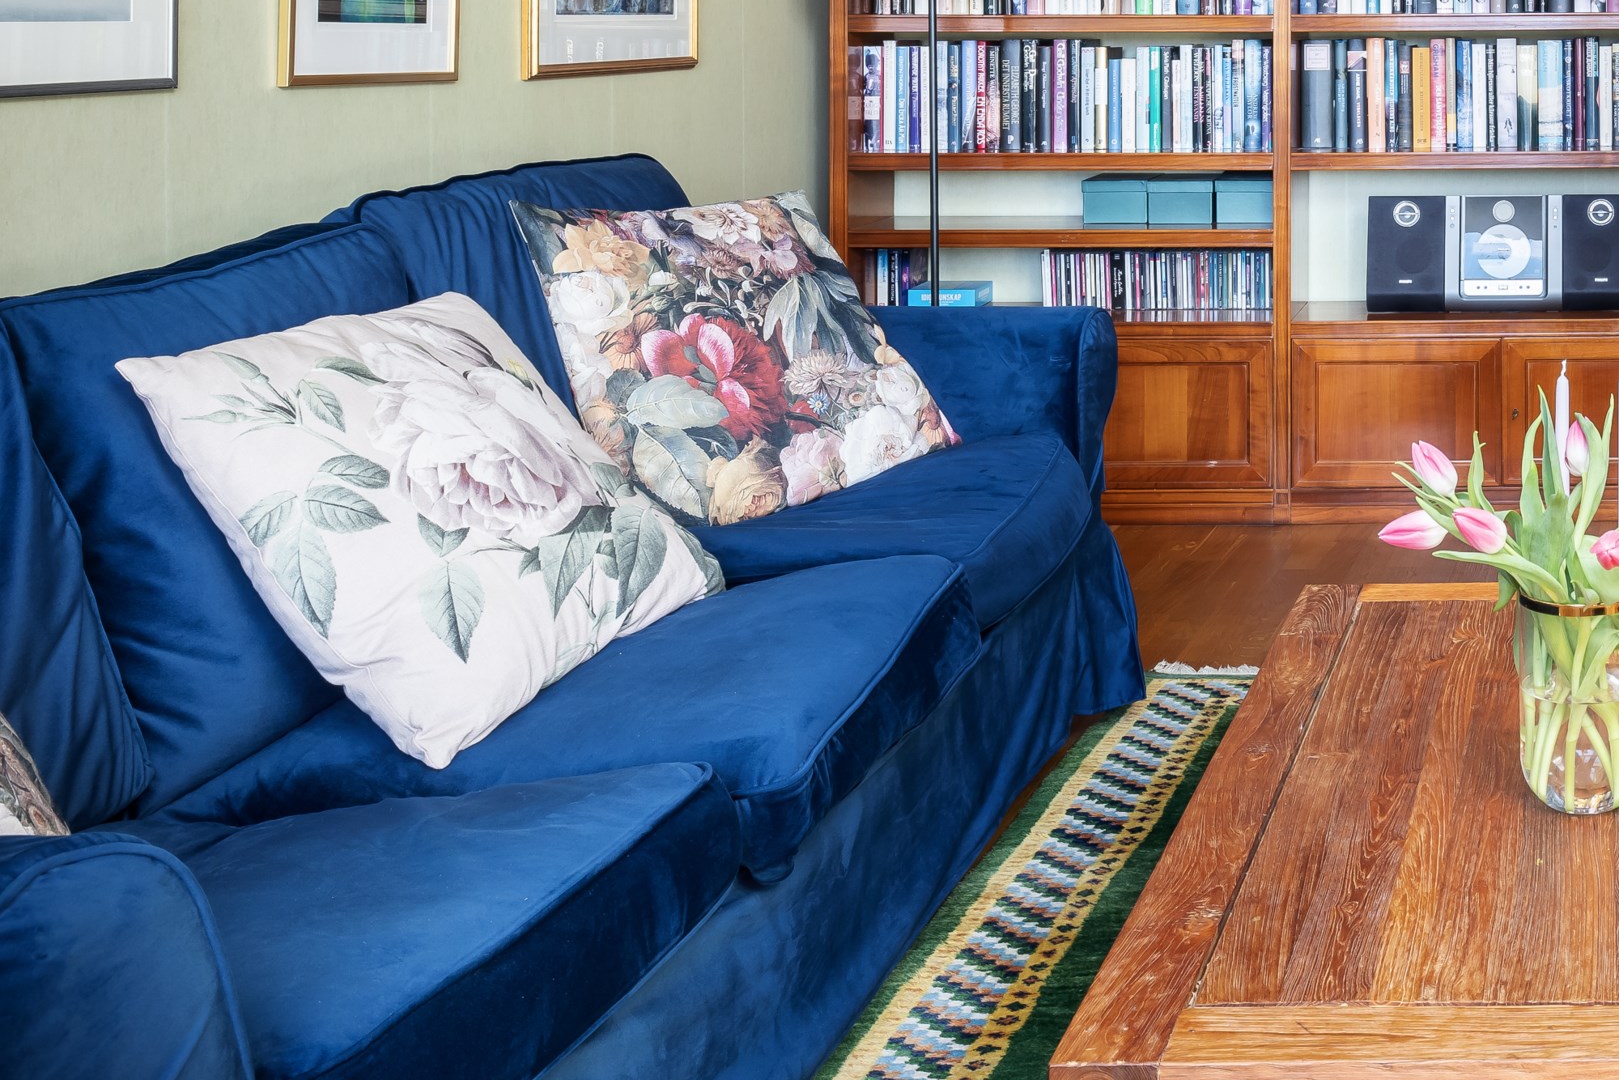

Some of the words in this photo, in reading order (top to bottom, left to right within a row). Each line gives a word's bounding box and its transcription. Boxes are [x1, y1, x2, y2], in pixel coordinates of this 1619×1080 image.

[1002, 59, 1010, 72] DET
[1432, 43, 1440, 78] GRISHAM
[1002, 71, 1010, 102] INNERSTA
[1010, 65, 1020, 98] ELIZABETH
[977, 96, 986, 106] EN
[1010, 98, 1020, 124] GEORGE
[977, 106, 986, 128] ENDA
[1002, 102, 1010, 131] RUMMET
[977, 128, 986, 145] ROS
